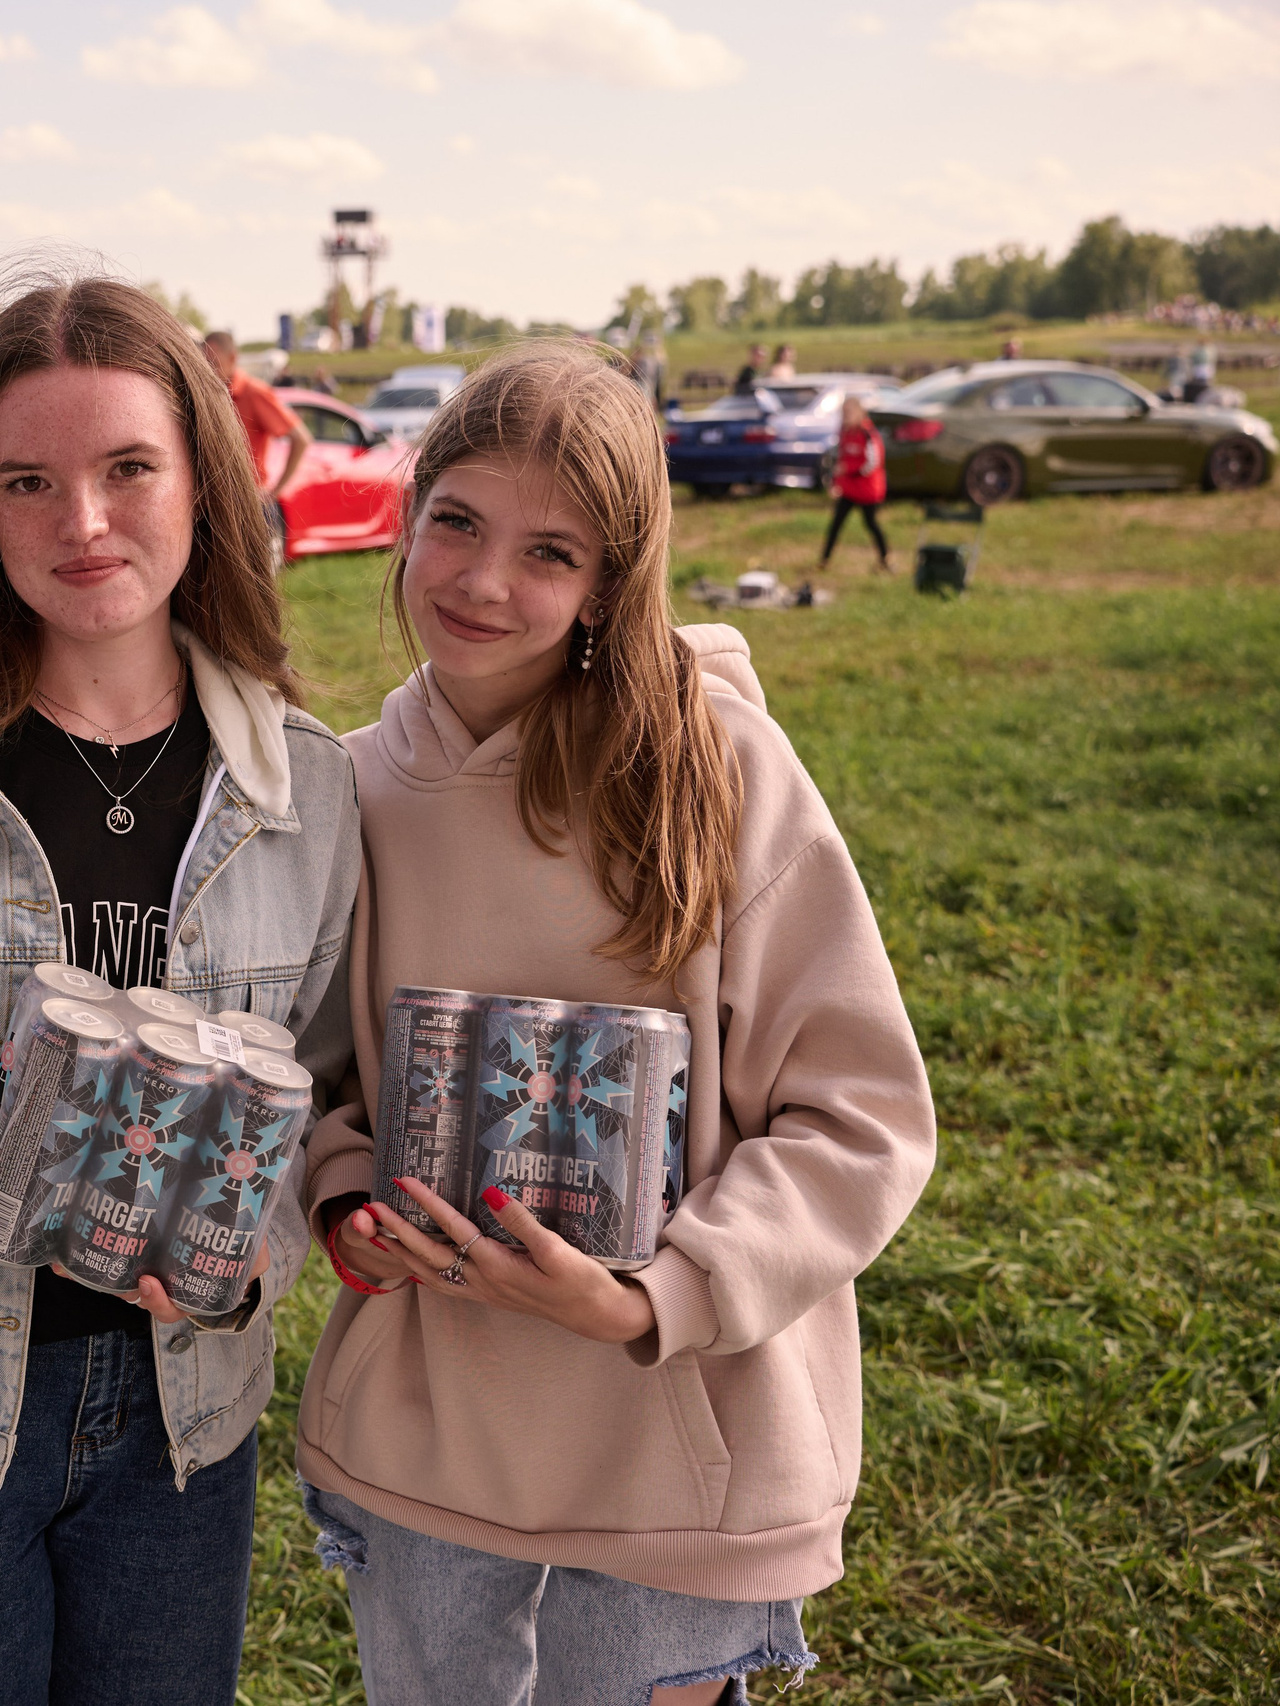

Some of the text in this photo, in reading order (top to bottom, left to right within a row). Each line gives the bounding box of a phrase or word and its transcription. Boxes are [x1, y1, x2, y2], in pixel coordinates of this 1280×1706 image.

[157, 1059, 177, 1069] FLAVOR
[137, 1073, 182, 1094] ENERGY
[237, 1098, 283, 1118] ENERGY
[83, 1181, 157, 1234] TARGET
[177, 1206, 255, 1256] TARGET
[92, 1226, 148, 1257] BERRY
[85, 1248, 110, 1265] TARGET
[85, 1258, 108, 1274] GOALS
[192, 1252, 246, 1278] BERRY
[184, 1273, 211, 1288] TARGET
[184, 1282, 208, 1297] GOALS
